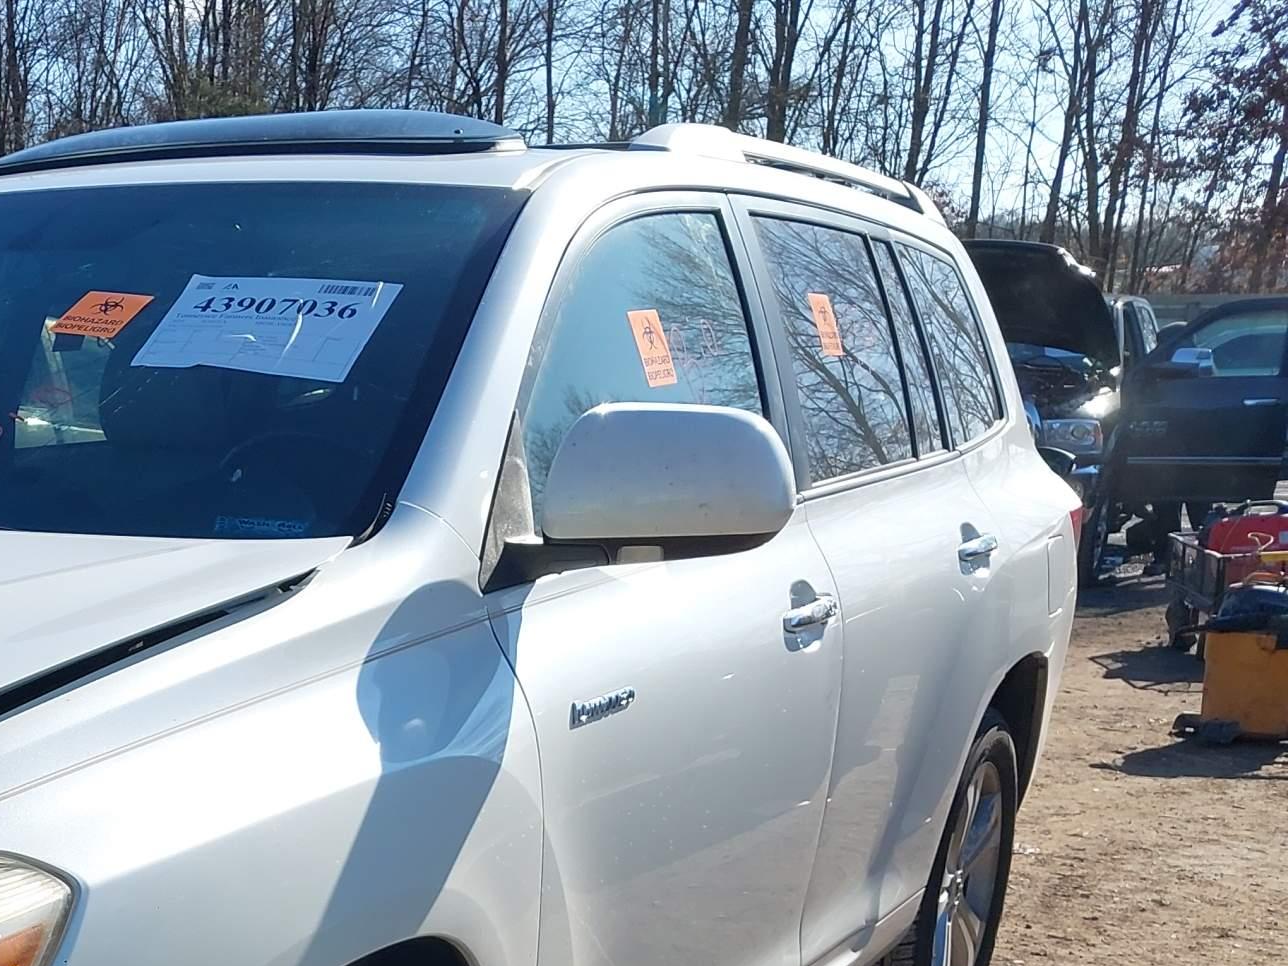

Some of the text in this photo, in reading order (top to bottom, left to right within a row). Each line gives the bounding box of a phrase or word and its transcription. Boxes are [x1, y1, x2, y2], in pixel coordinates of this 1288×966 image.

[193, 296, 361, 320] 43907036
[62, 315, 124, 326] BIOHAZARD
[55, 322, 117, 334] BIOPELIGRO
